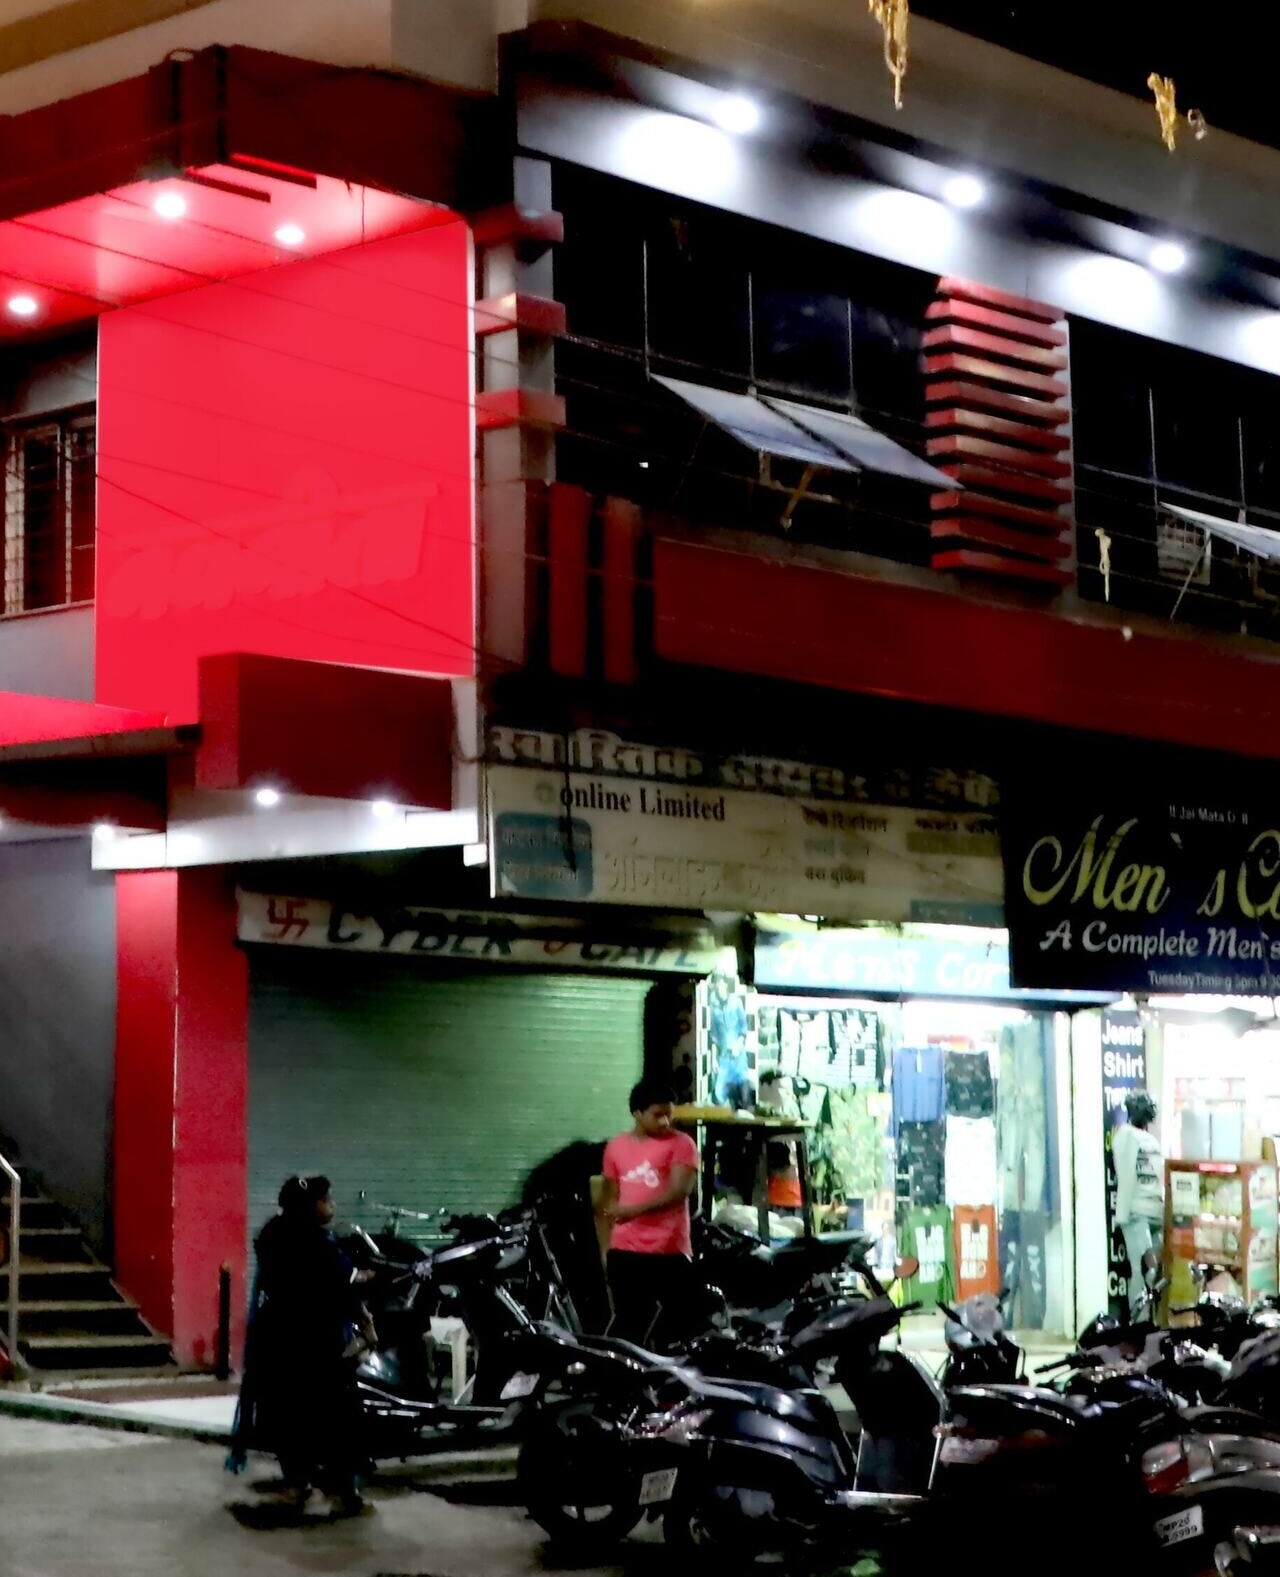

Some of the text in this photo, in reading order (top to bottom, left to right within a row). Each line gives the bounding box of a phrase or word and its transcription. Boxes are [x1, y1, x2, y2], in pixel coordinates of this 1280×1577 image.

[640, 786, 726, 822] Limited
[1040, 920, 1073, 951] A
[1082, 920, 1200, 960] Complete
[1102, 1020, 1144, 1047] Jeans
[1103, 1052, 1145, 1079] Shirt
